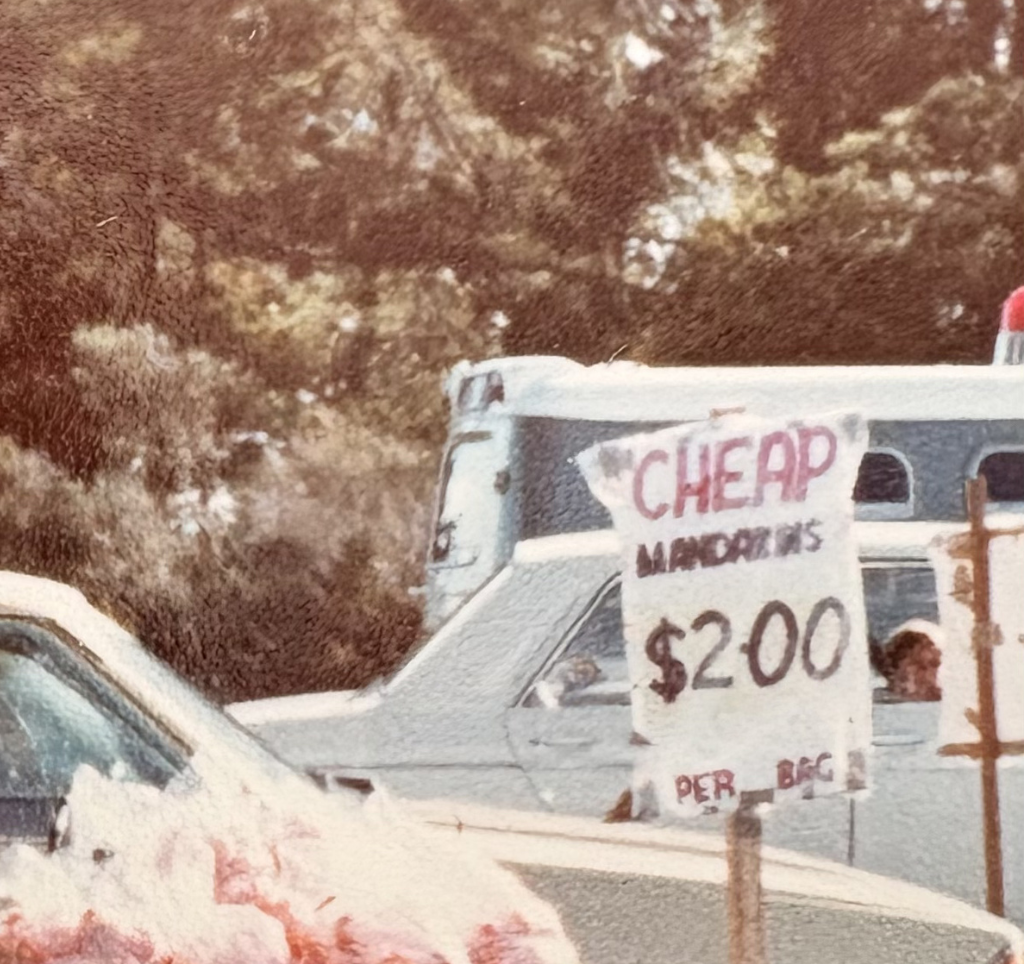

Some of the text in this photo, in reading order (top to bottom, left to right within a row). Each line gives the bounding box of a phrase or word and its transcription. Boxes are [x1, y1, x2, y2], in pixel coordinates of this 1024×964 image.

[632, 426, 837, 520] CHEAP
[636, 519, 823, 578] MANDARINS
[675, 752, 833, 802] PER BAG
